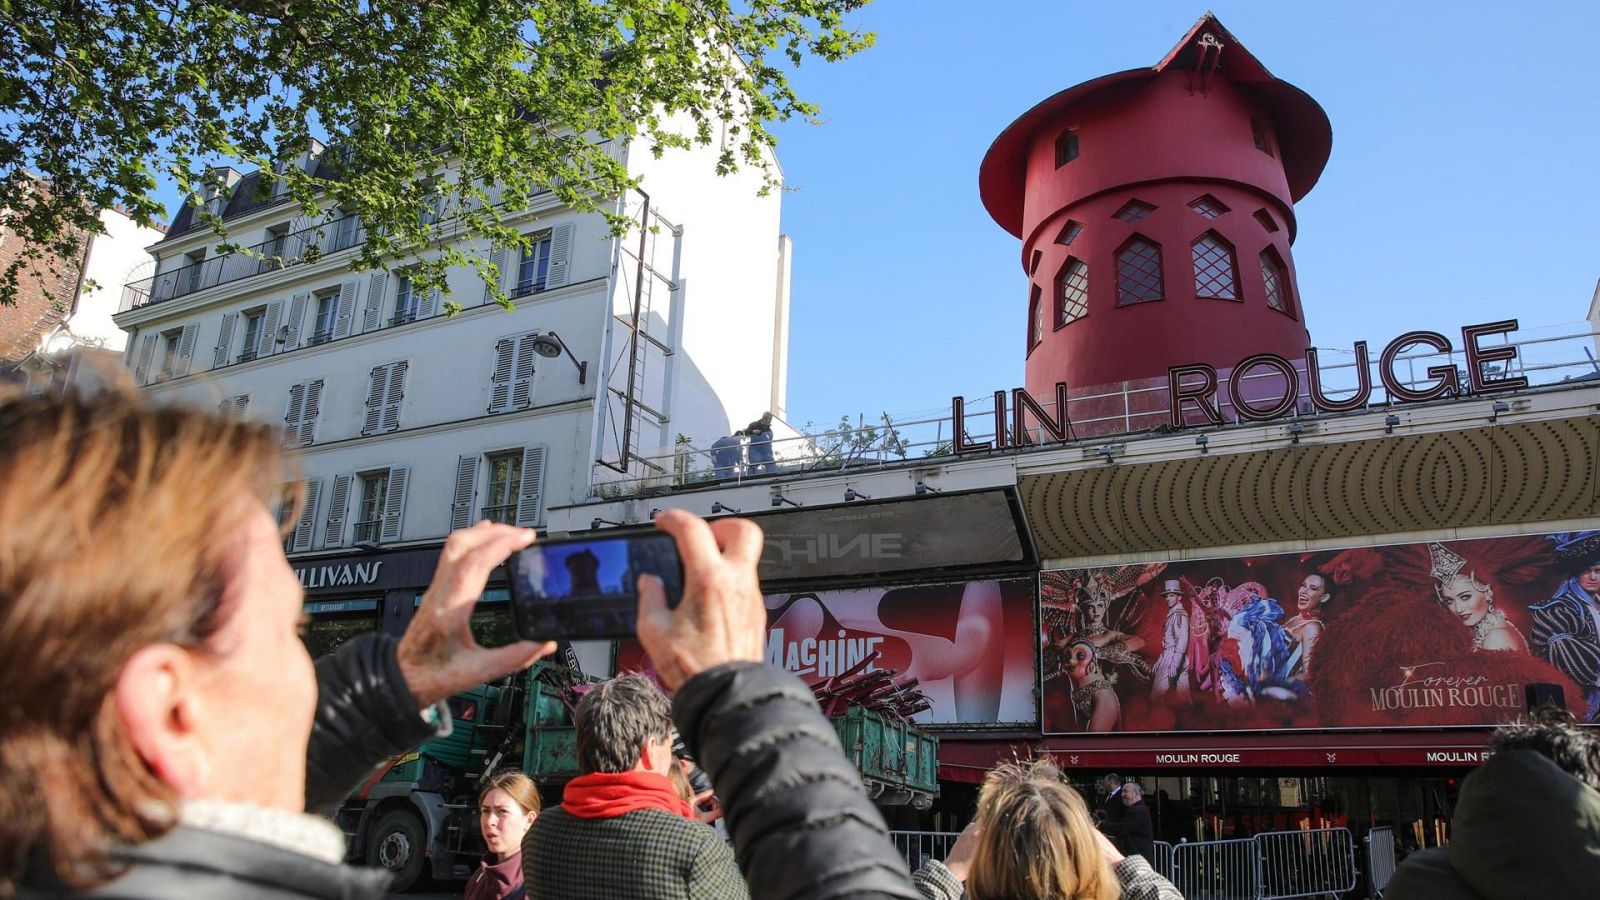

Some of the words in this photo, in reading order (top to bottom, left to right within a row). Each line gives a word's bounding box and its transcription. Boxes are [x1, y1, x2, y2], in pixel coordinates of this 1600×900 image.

[952, 381, 1069, 456] LIN
[1168, 319, 1528, 427] ROUGE
[295, 561, 383, 588] LLIVANS
[1390, 661, 1489, 696] Forever
[1370, 686, 1444, 711] MOULIN
[1450, 683, 1521, 708] ROUGE
[1156, 754, 1198, 764] MOULIN
[1201, 753, 1240, 763] ROUGE
[1427, 752, 1478, 762] MOULIN
